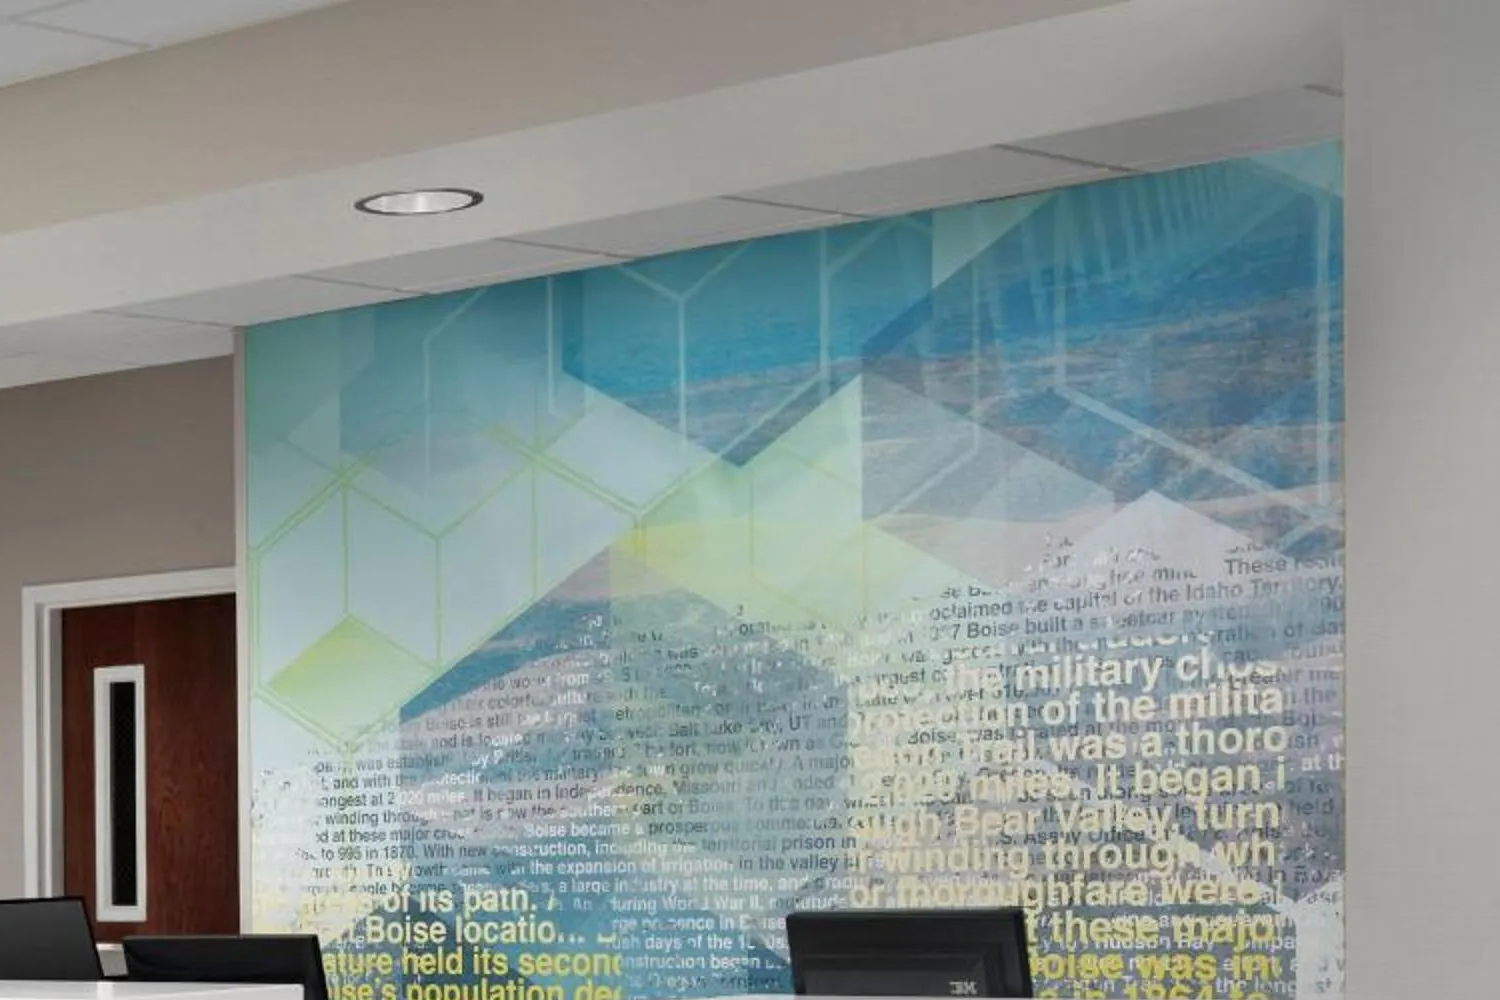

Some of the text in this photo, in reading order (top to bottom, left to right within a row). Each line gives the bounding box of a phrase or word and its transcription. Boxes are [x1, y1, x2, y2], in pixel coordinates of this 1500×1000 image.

[1226, 557, 1286, 577] These
[1150, 585, 1182, 604] the
[1187, 580, 1242, 602] Idaho
[1025, 617, 1068, 635] built
[1014, 653, 1163, 696] military
[1041, 692, 1082, 727] of
[1092, 689, 1156, 723] the
[1169, 682, 1284, 718] milita
[1049, 732, 1128, 764] was
[1140, 731, 1163, 757] a
[1177, 721, 1288, 757] thoro
[1134, 759, 1263, 804] began
[325, 809, 379, 828] winding
[1194, 795, 1280, 831] turn
[320, 846, 335, 861] to
[366, 844, 379, 859] in
[422, 841, 455, 858] With
[781, 830, 837, 851] prison
[841, 829, 858, 847] in
[332, 826, 429, 847] at these major
[529, 858, 554, 875] the
[739, 853, 754, 870] in
[758, 850, 785, 869] the
[788, 847, 839, 872] valley
[420, 885, 454, 913] its
[463, 885, 538, 921] path.
[365, 914, 447, 944] Boise
[644, 933, 683, 954] days
[707, 931, 734, 949] the
[1051, 908, 1159, 946] these
[402, 946, 464, 979] held
[472, 946, 510, 977] its
[1136, 953, 1218, 982] was
